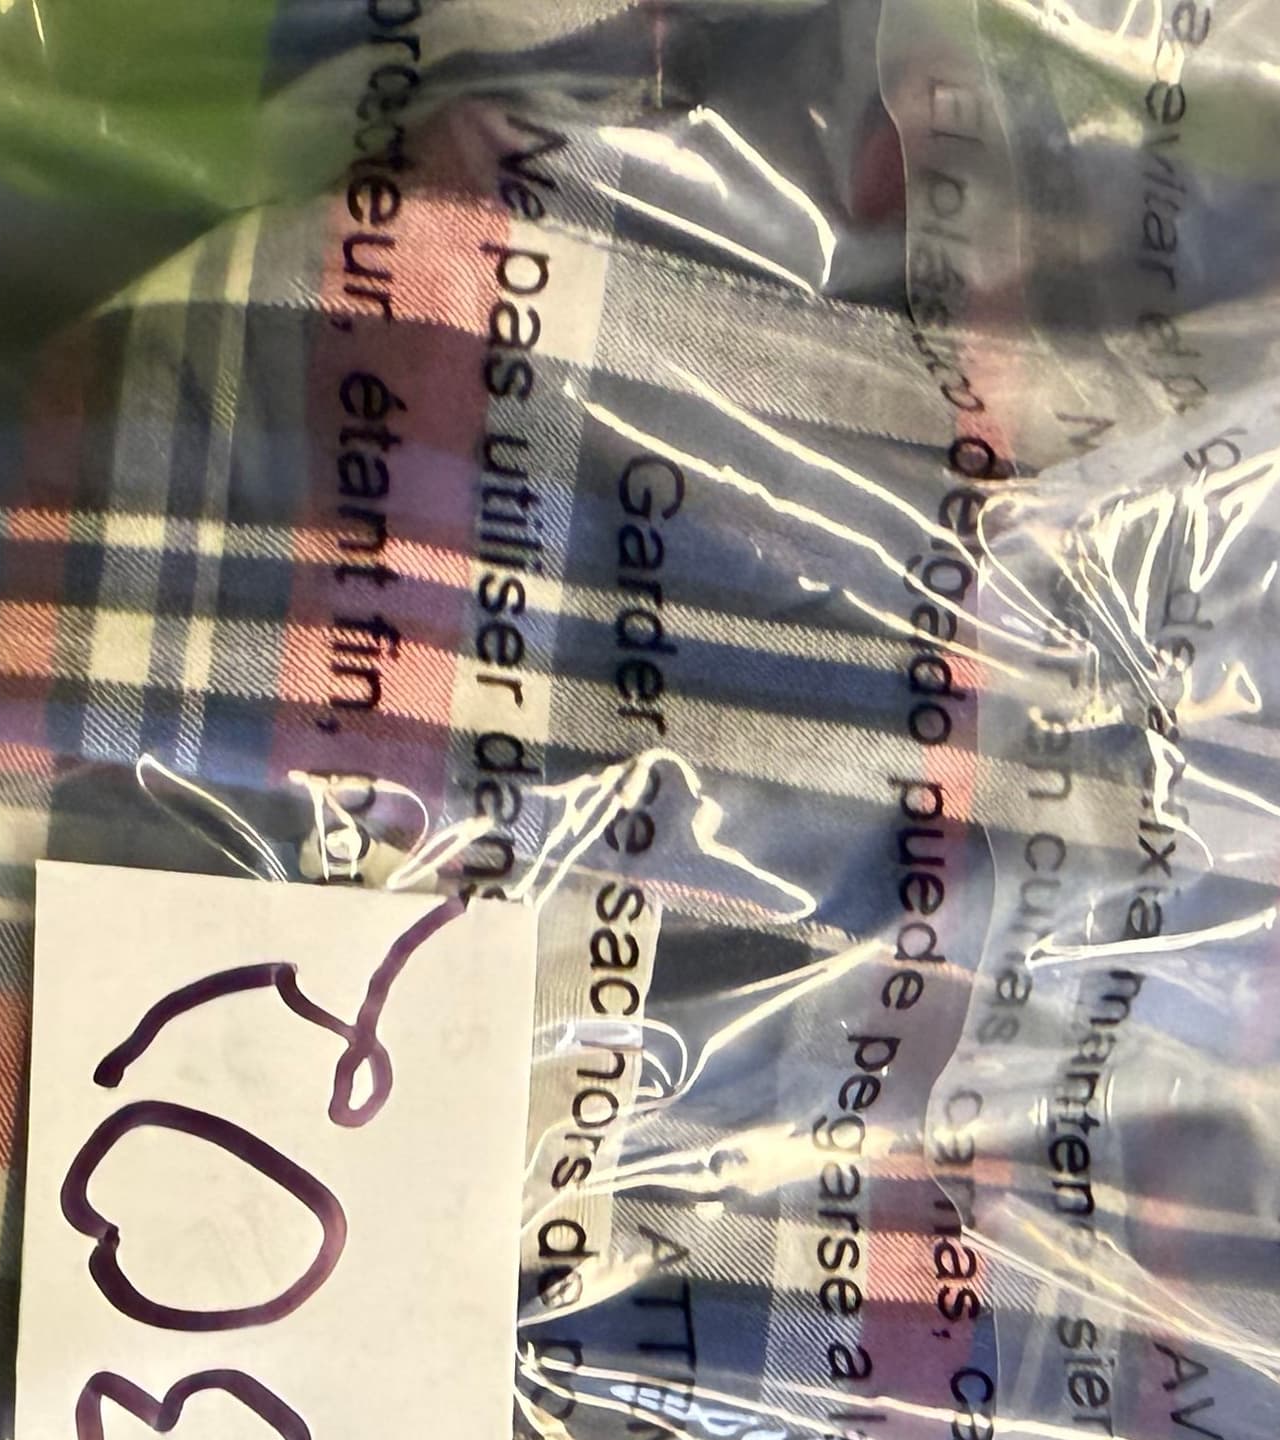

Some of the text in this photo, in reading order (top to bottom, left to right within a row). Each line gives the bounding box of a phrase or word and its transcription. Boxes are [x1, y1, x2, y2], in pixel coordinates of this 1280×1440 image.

[498, 117, 567, 223] Ne
[477, 244, 551, 400] pas
[333, 370, 408, 589] étant
[473, 433, 543, 708] utiliser
[314, 614, 403, 736] fin,
[614, 454, 685, 736] Garder
[900, 436, 1017, 747] delgado
[588, 881, 644, 1017] sac
[879, 780, 951, 1011] puede
[548, 1042, 645, 1192] hors
[810, 1033, 903, 1317] pegarse
[825, 1342, 873, 1383] a
